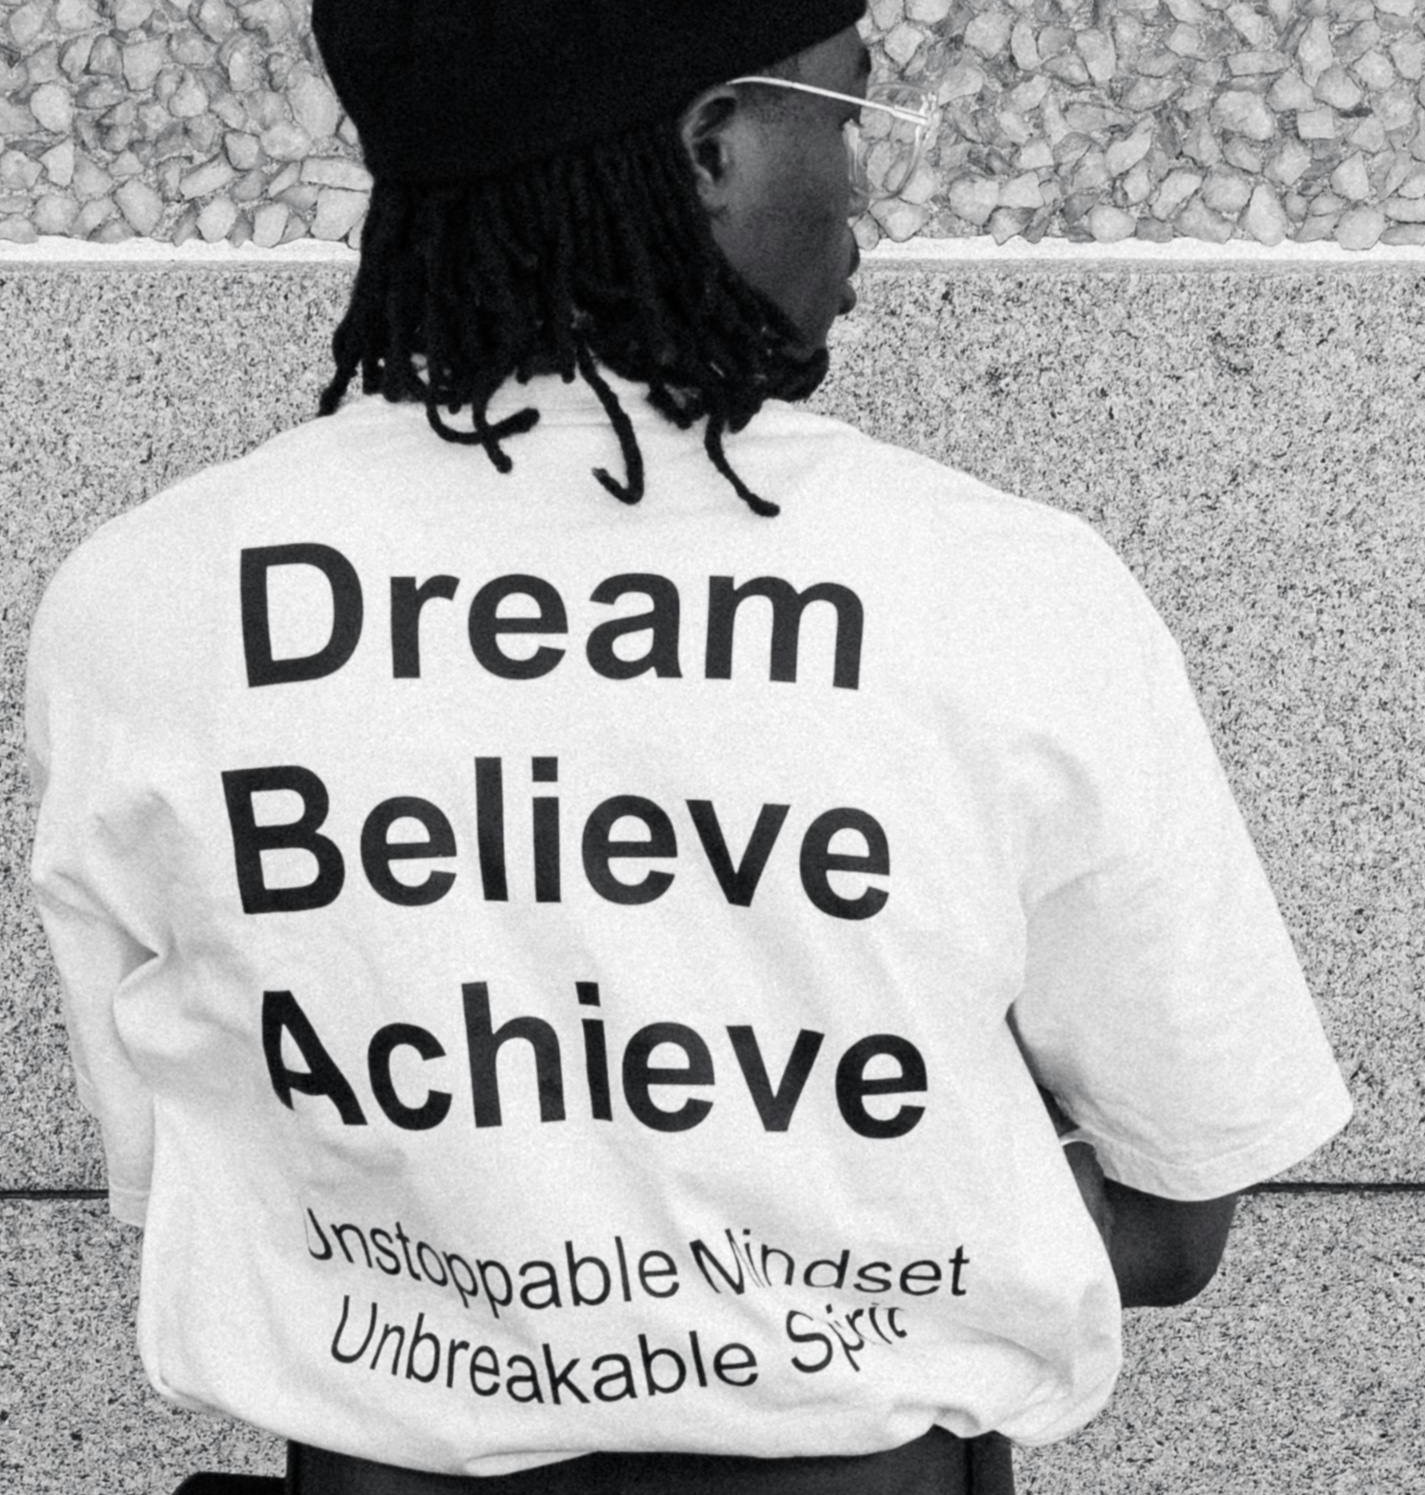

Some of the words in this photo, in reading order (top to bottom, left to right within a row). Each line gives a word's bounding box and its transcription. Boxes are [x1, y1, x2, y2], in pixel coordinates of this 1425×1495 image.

[239, 542, 865, 691] Dream
[220, 755, 891, 922] Believe
[260, 980, 929, 1140] Achieve
[330, 1294, 760, 1406] Unbreakable
